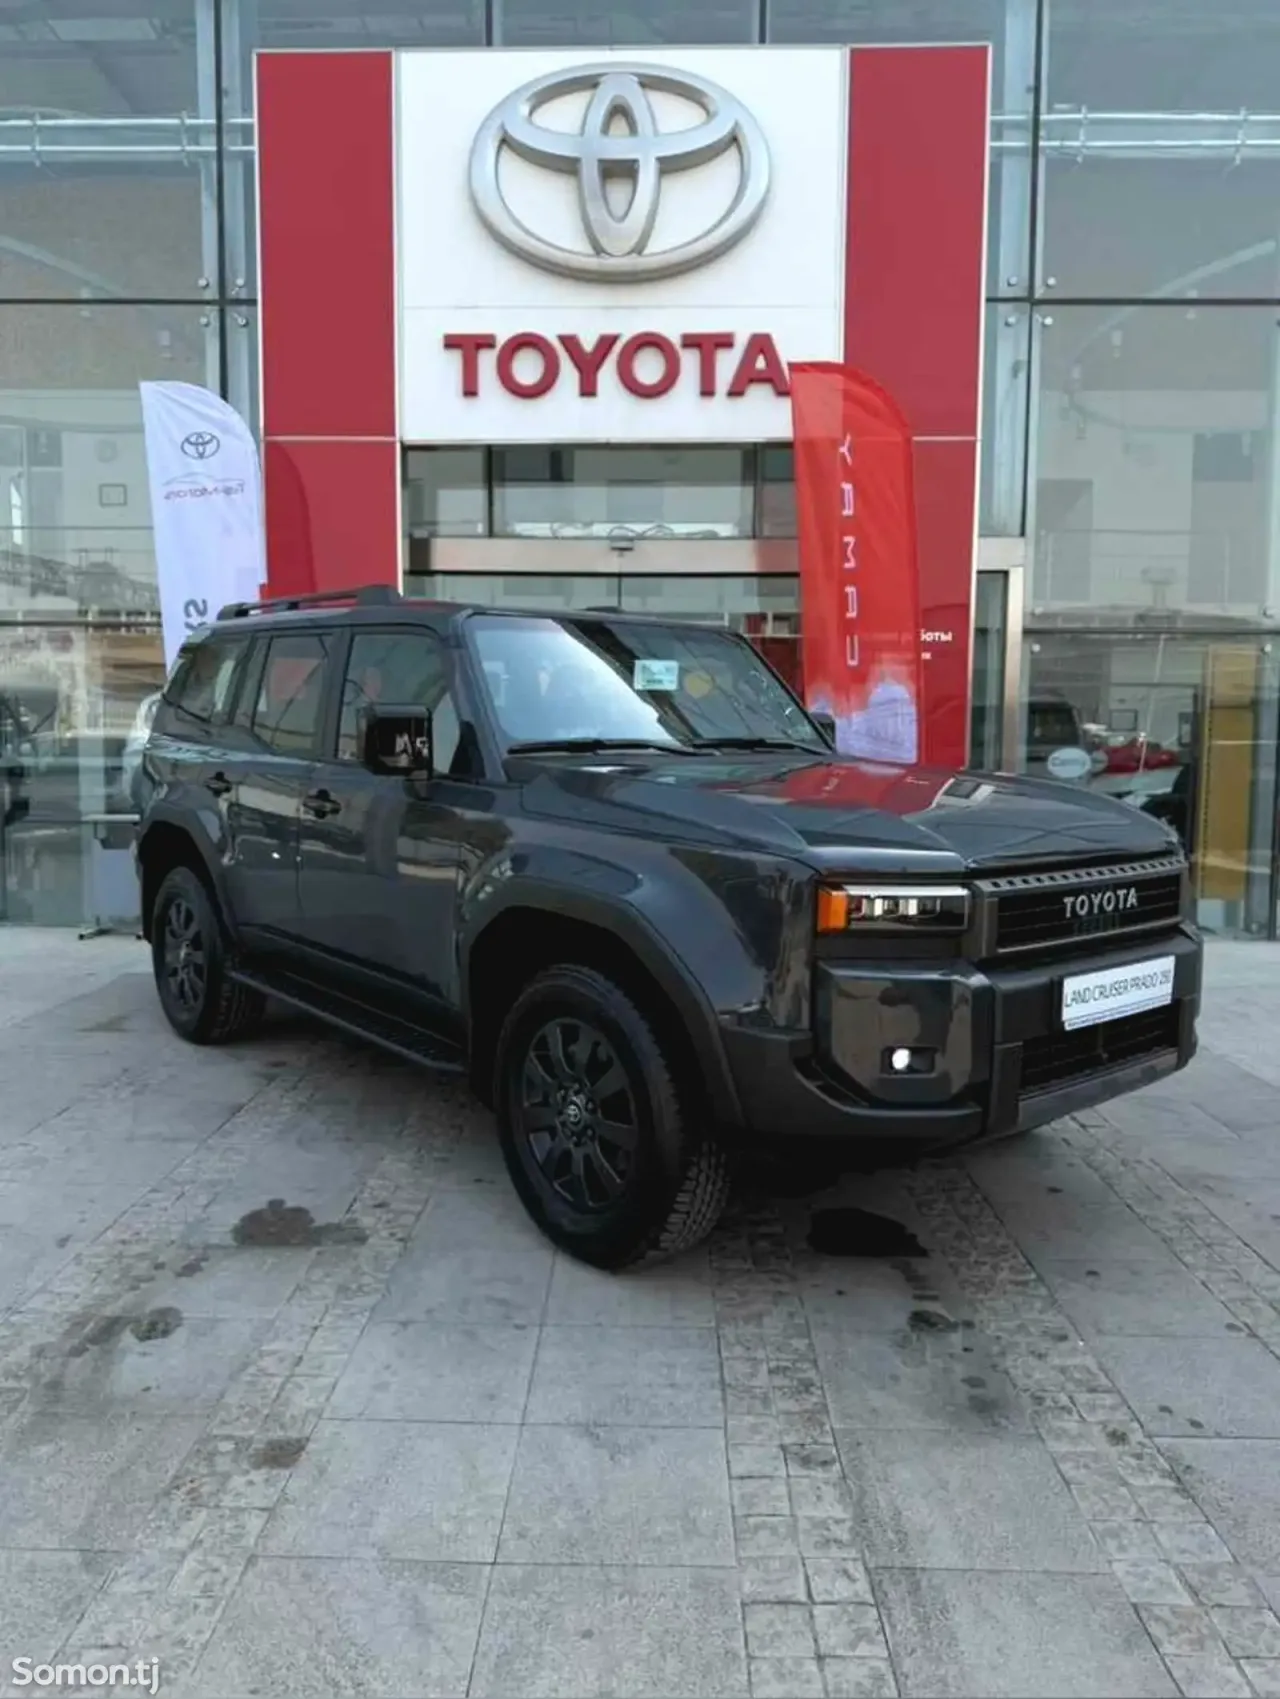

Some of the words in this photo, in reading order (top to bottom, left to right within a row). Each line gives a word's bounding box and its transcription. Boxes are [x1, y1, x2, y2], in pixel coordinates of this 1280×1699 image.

[444, 332, 792, 399] TOYOTA
[1063, 887, 1138, 918] TOYOTA
[1064, 987, 1092, 1007] LAND
[1093, 977, 1129, 1000] CRUISER
[1130, 971, 1158, 991] PRADO
